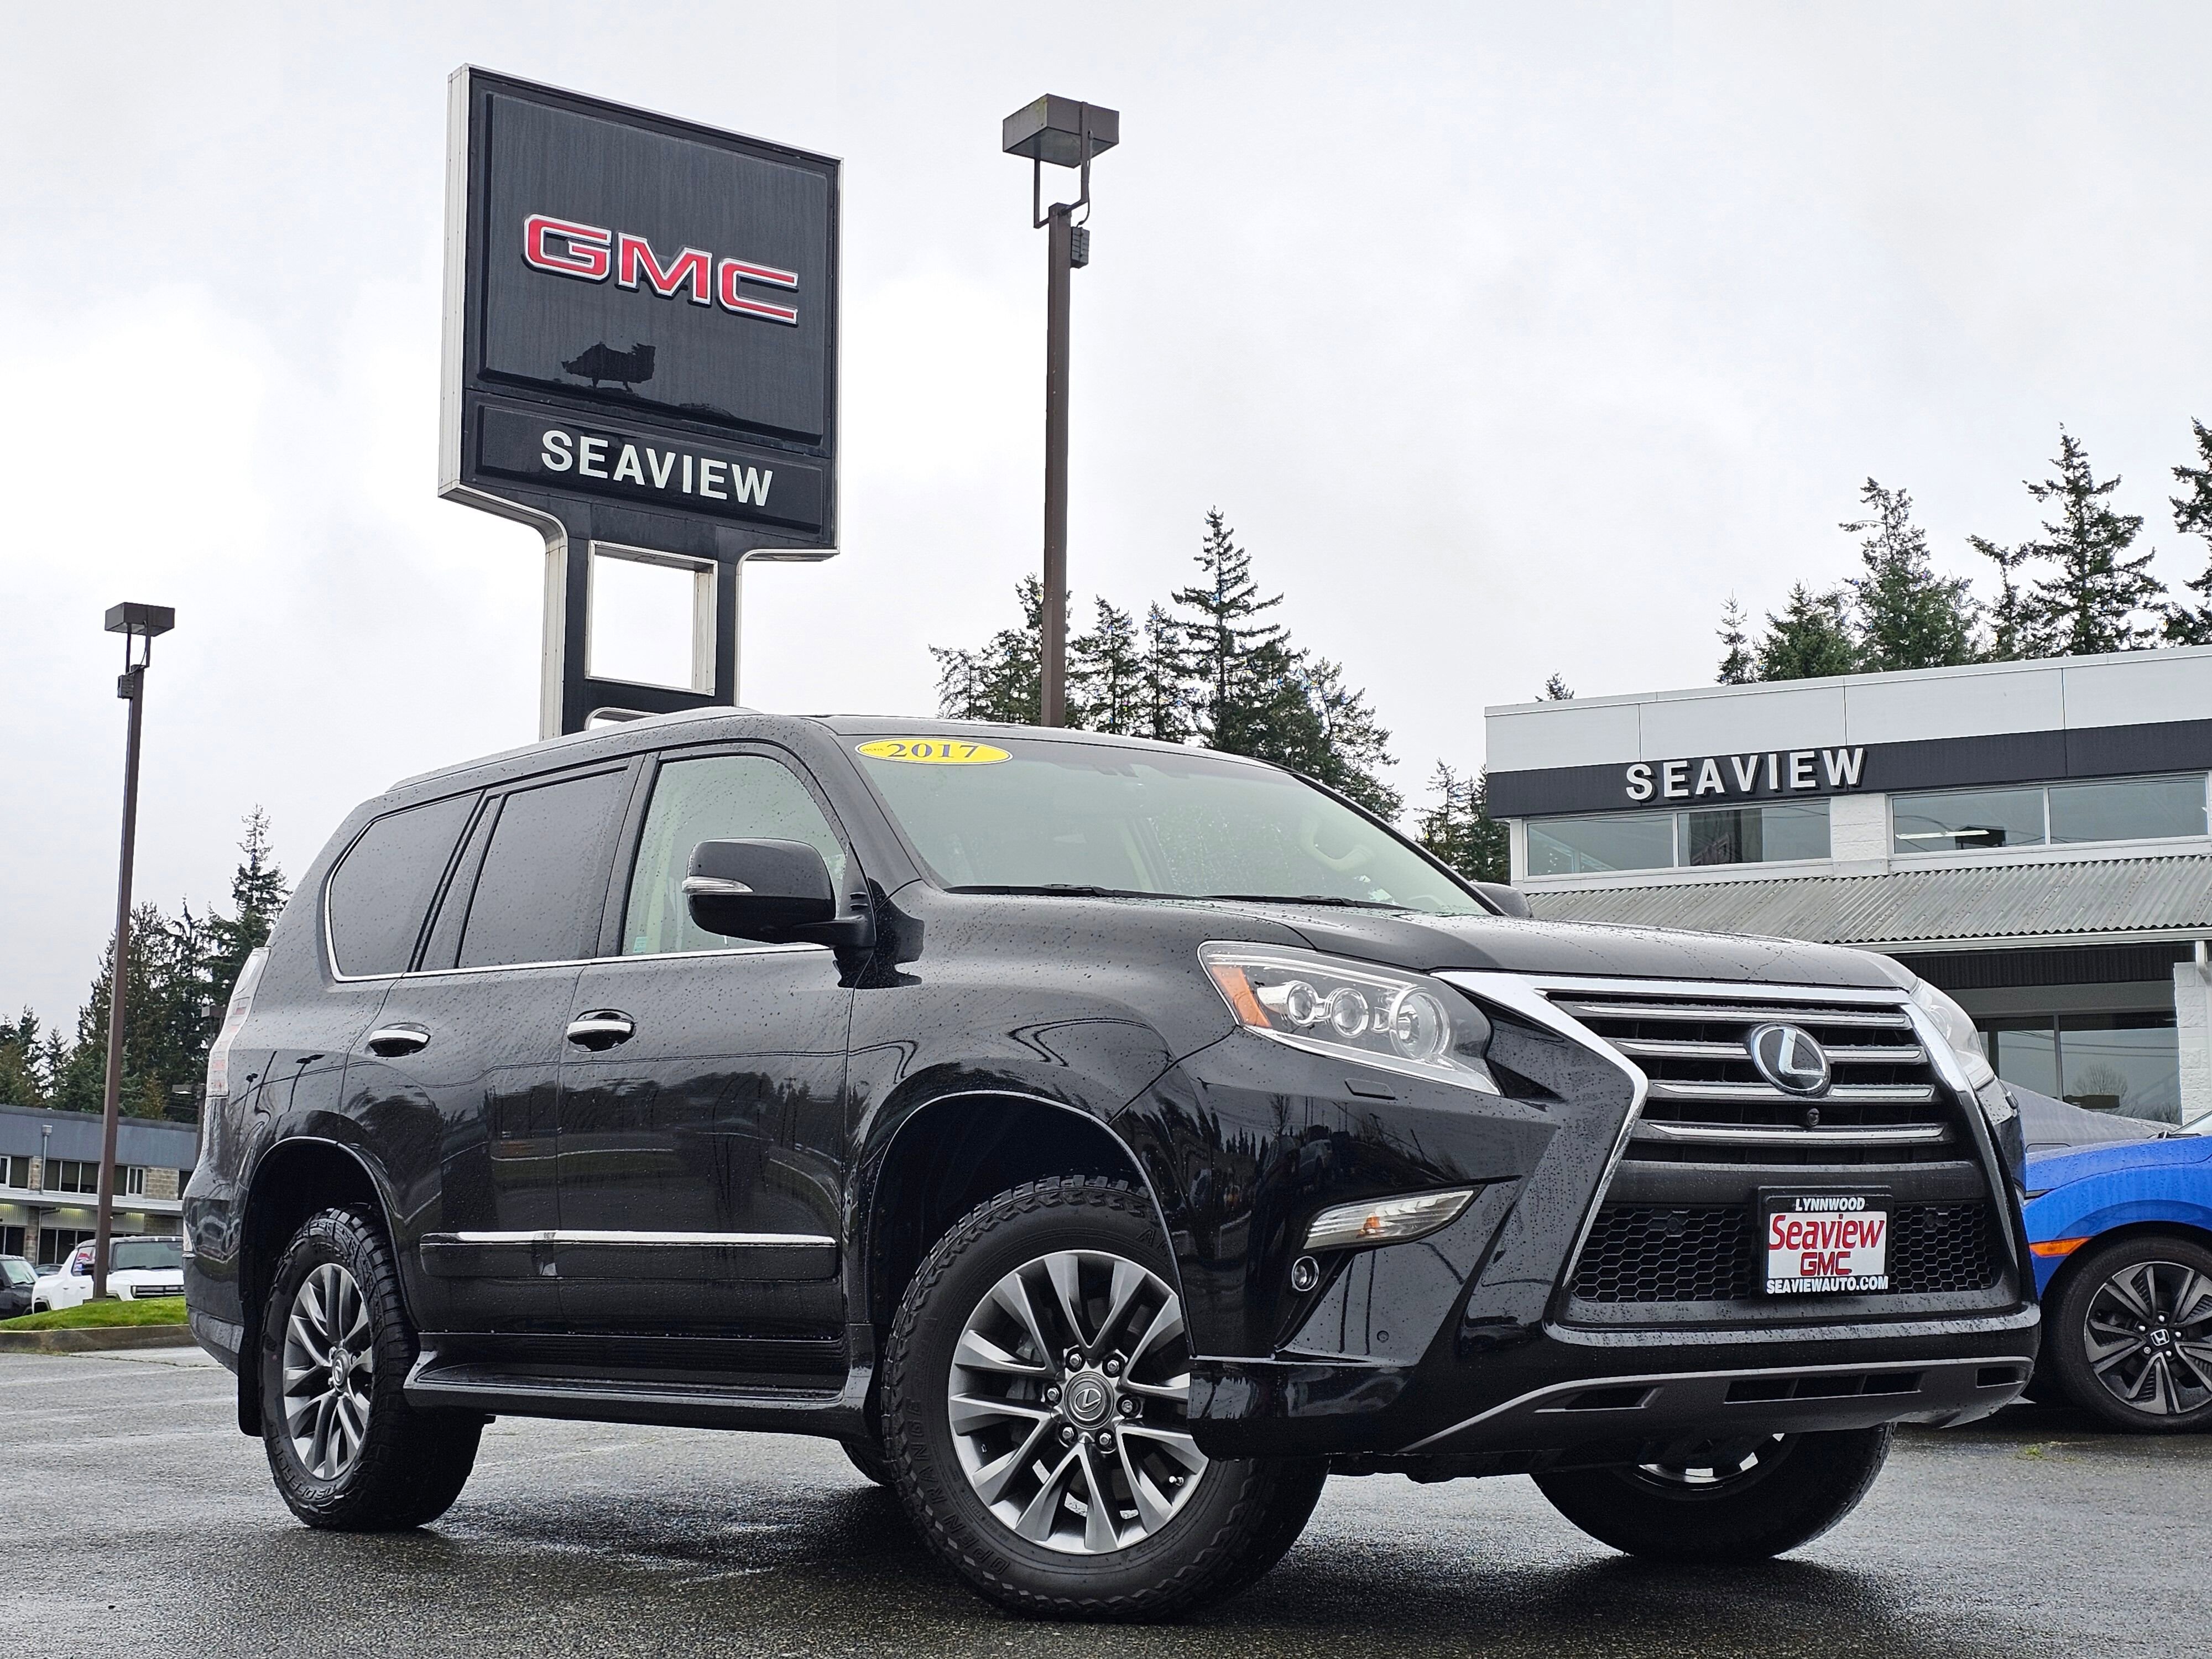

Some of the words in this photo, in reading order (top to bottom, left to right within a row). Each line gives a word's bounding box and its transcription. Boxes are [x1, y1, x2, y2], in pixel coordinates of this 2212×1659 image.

[524, 213, 799, 325] GMC
[541, 430, 773, 507] SEAVIEW
[886, 744, 979, 758] 2017
[1626, 747, 1865, 800] SEAVIEW
[1795, 1198, 1865, 1211] LYNNWOOD
[1768, 1214, 1885, 1250] Seaview
[1766, 1276, 1888, 1294] SEAVIEWAUTO.COM
[1800, 1251, 1853, 1276] GMC
[906, 1397, 947, 1505] RANGE
[942, 1512, 1010, 1575] OPEN
